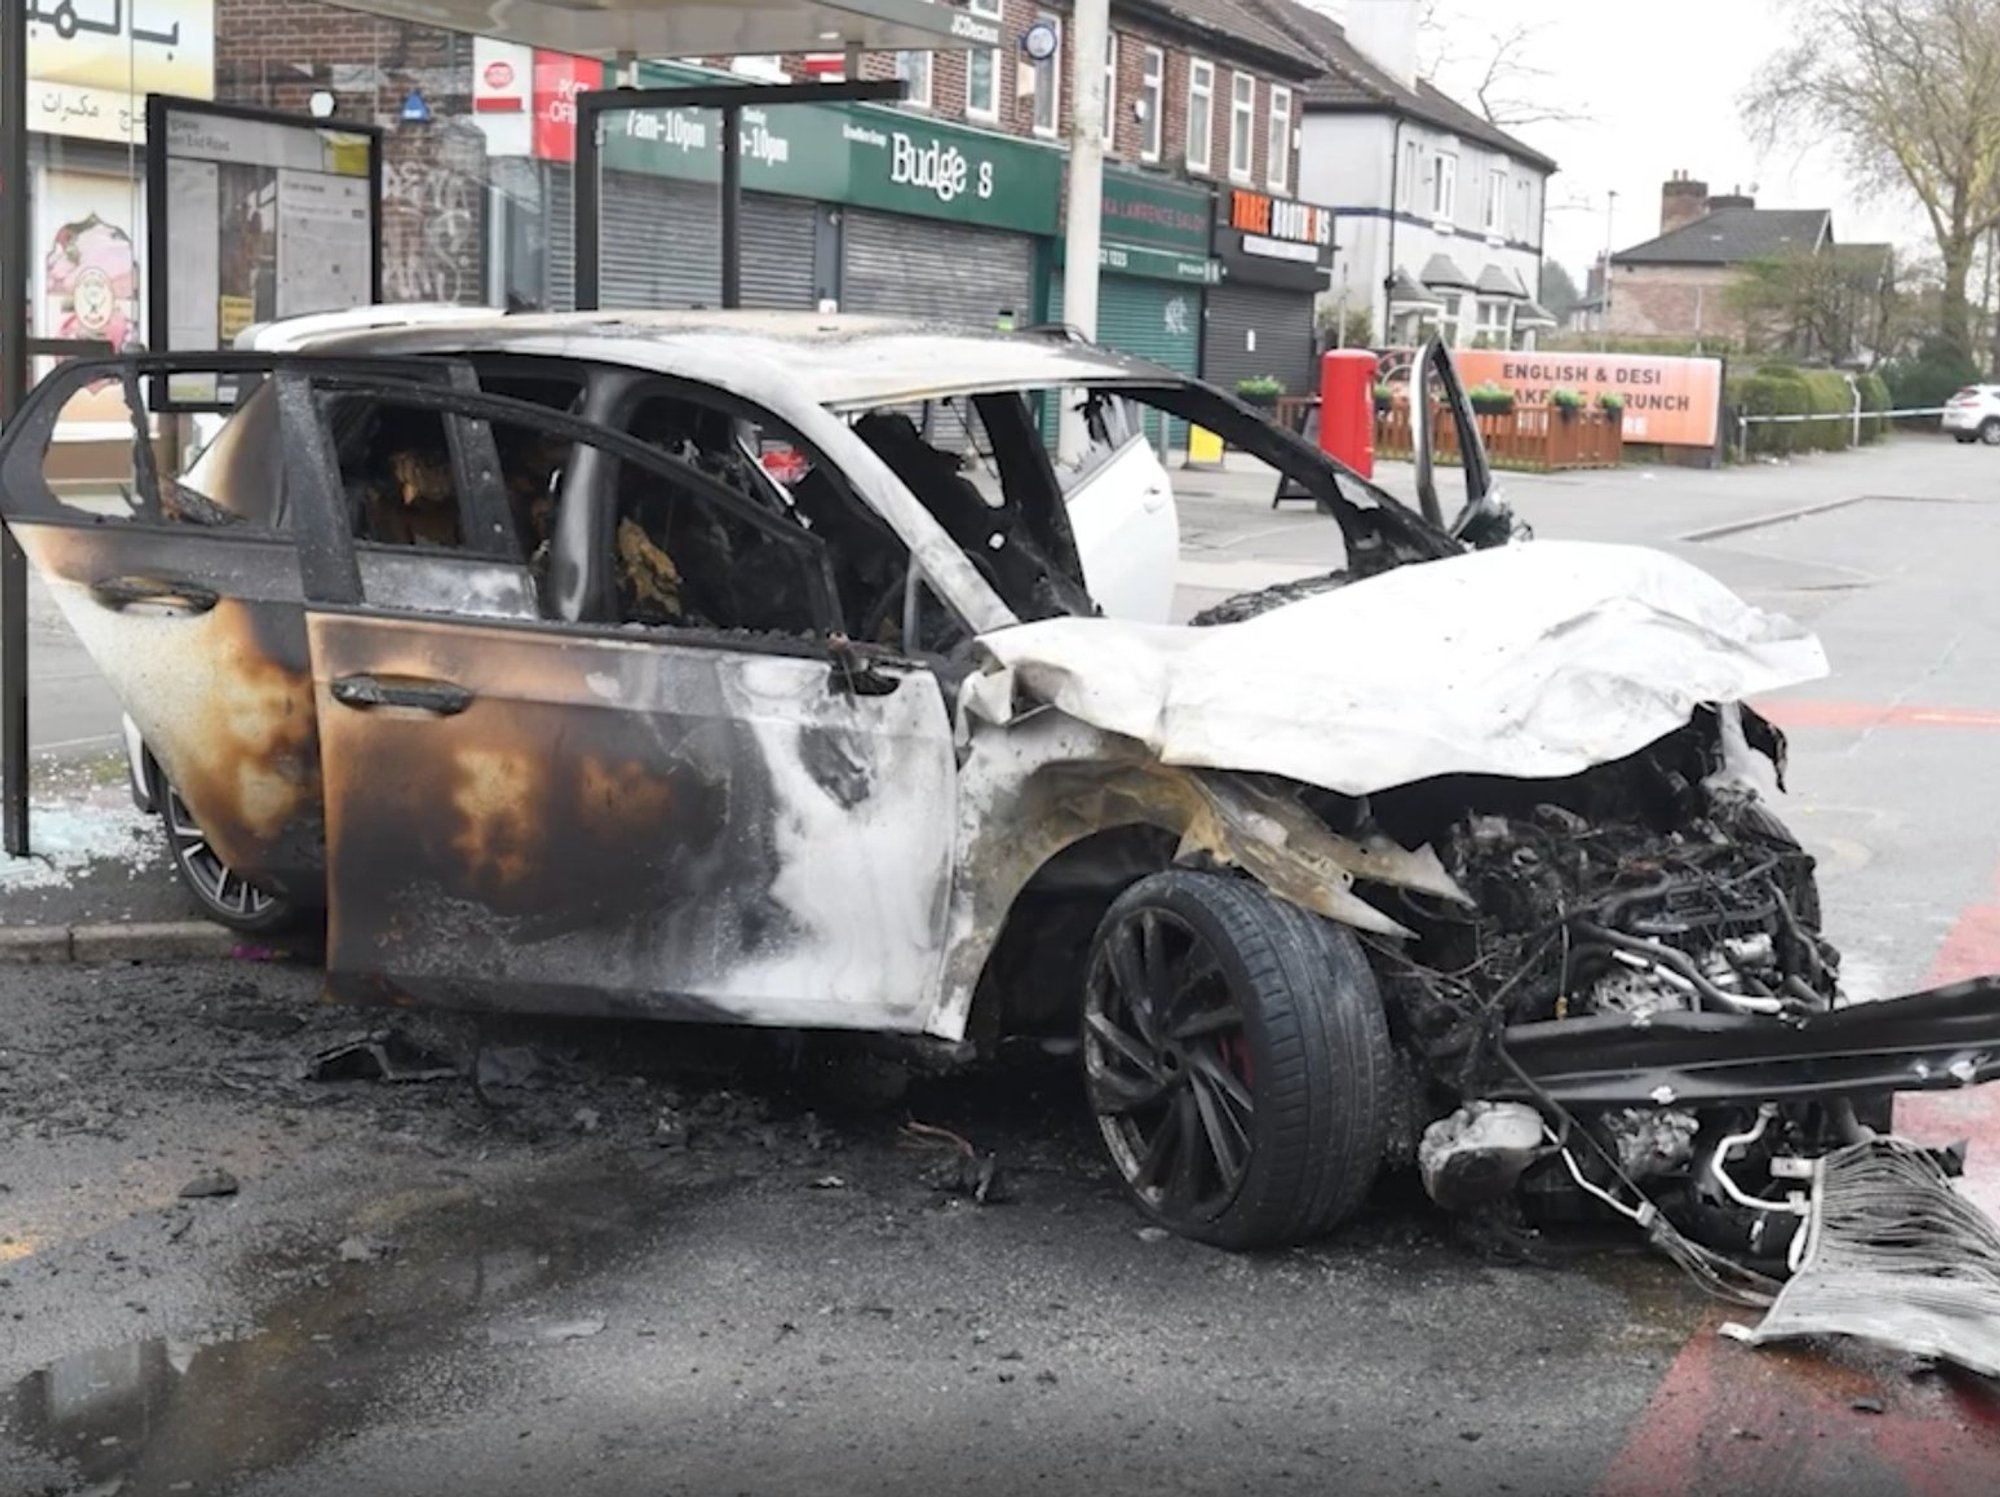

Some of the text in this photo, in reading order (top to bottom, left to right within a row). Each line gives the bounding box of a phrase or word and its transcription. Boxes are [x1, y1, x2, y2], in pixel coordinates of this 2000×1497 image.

[891, 131, 993, 202] Budges
[1503, 363, 1661, 384] ENGLISH & DESI
[1625, 393, 1690, 411] RUNCH
